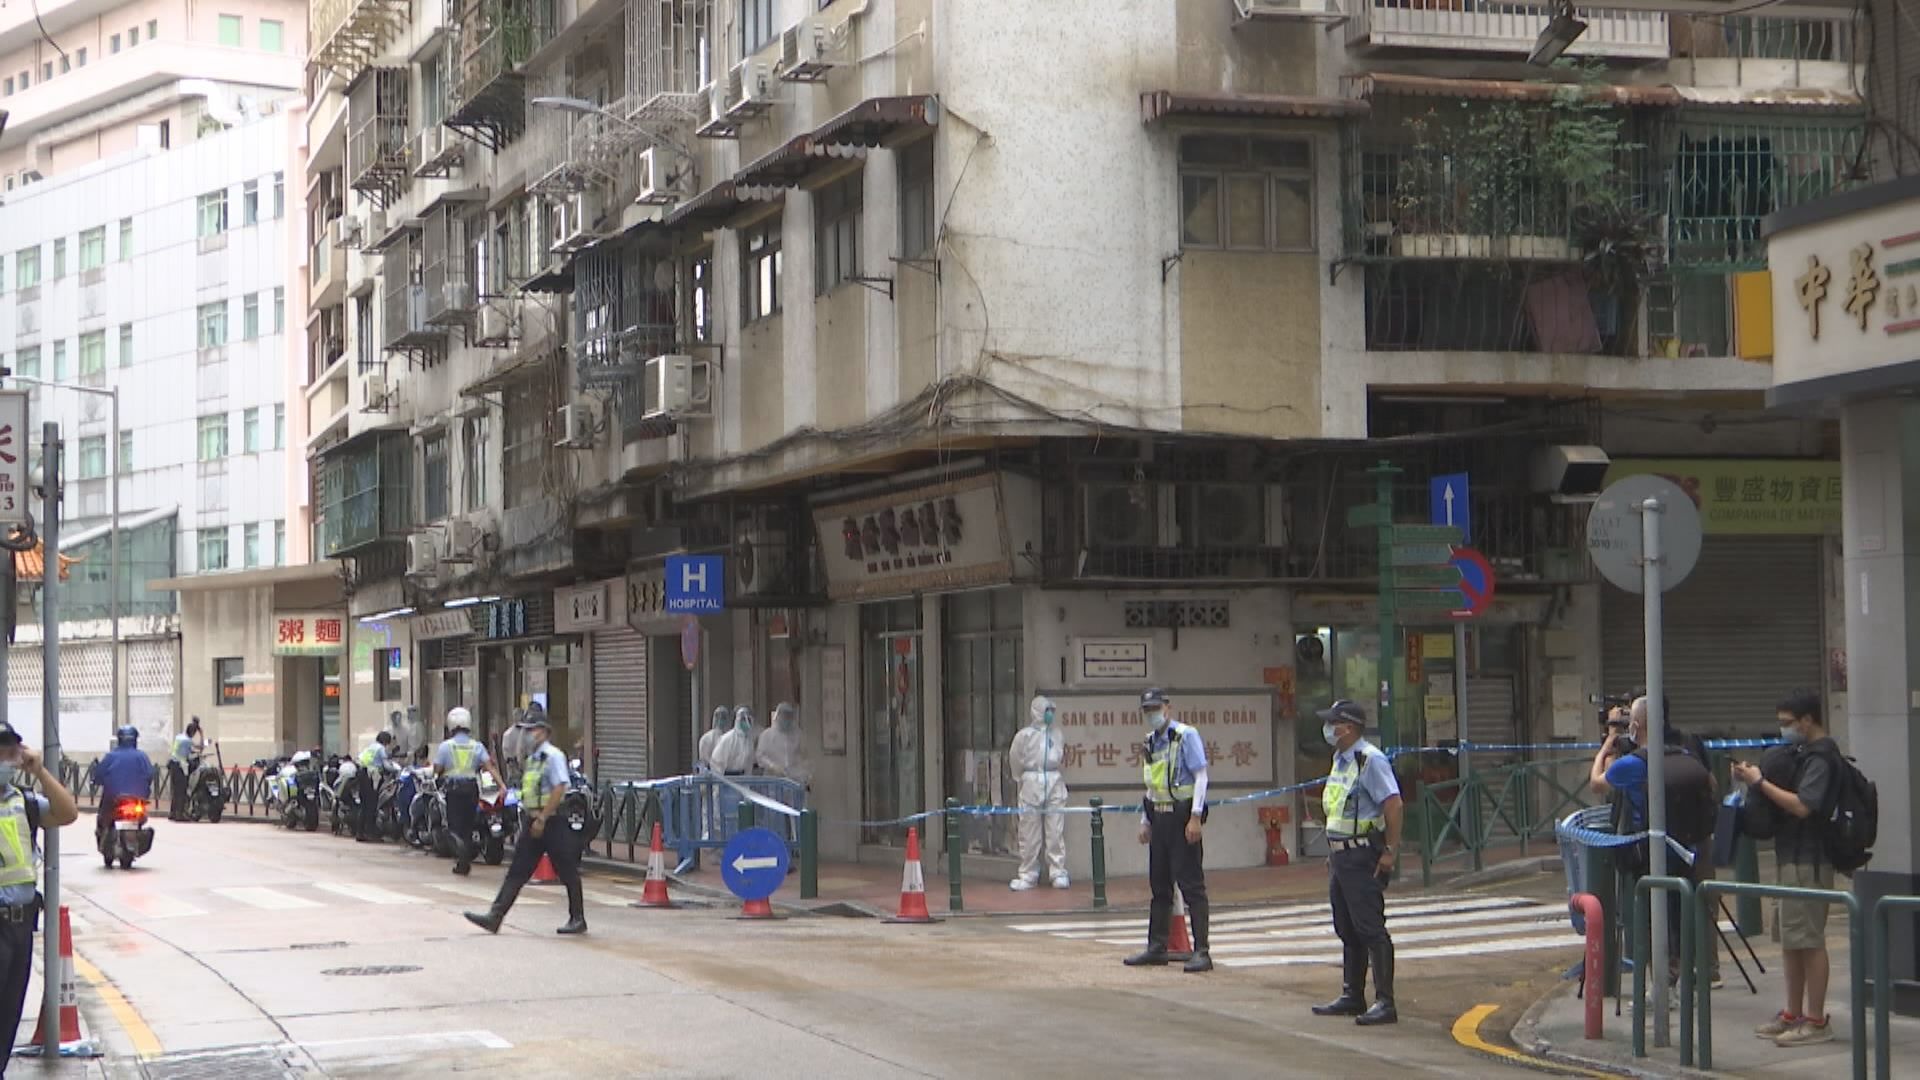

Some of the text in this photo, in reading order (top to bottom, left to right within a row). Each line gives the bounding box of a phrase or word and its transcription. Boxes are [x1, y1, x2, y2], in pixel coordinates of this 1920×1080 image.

[683, 563, 706, 592] H
[670, 599, 720, 608] HOSPITAL
[1062, 711, 1087, 726] SAN
[1093, 711, 1114, 726] SAI
